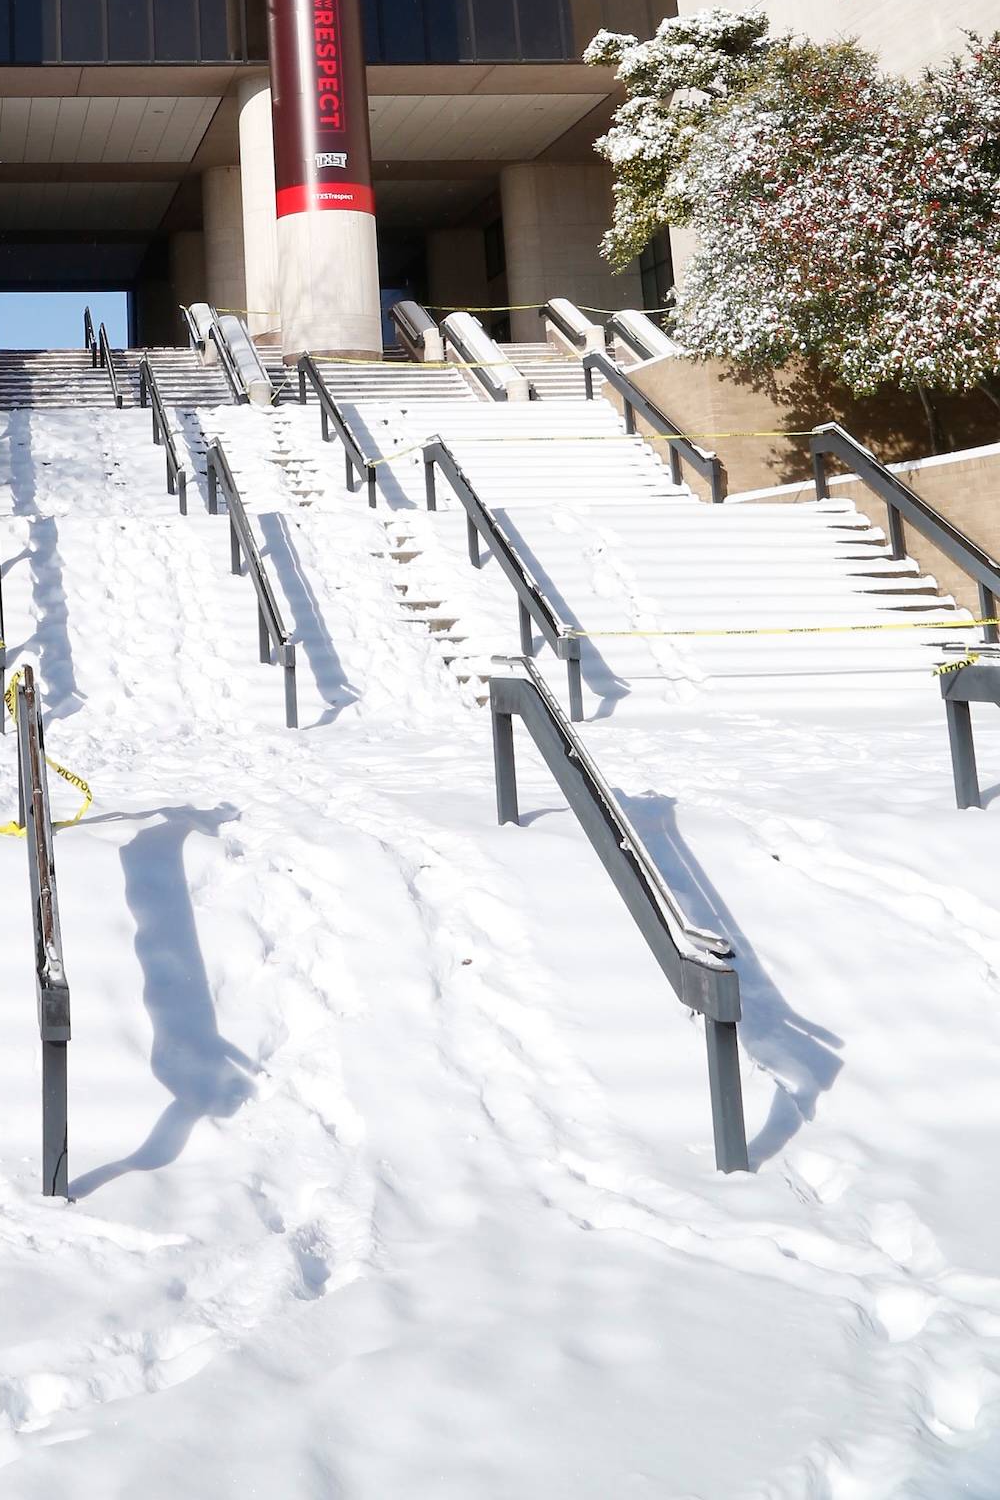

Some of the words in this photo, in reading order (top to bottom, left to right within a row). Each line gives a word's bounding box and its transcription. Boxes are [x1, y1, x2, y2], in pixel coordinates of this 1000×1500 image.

[313, 11, 339, 128] RESPECT
[314, 152, 348, 169] TXST
[932, 659, 976, 677] AUTION
